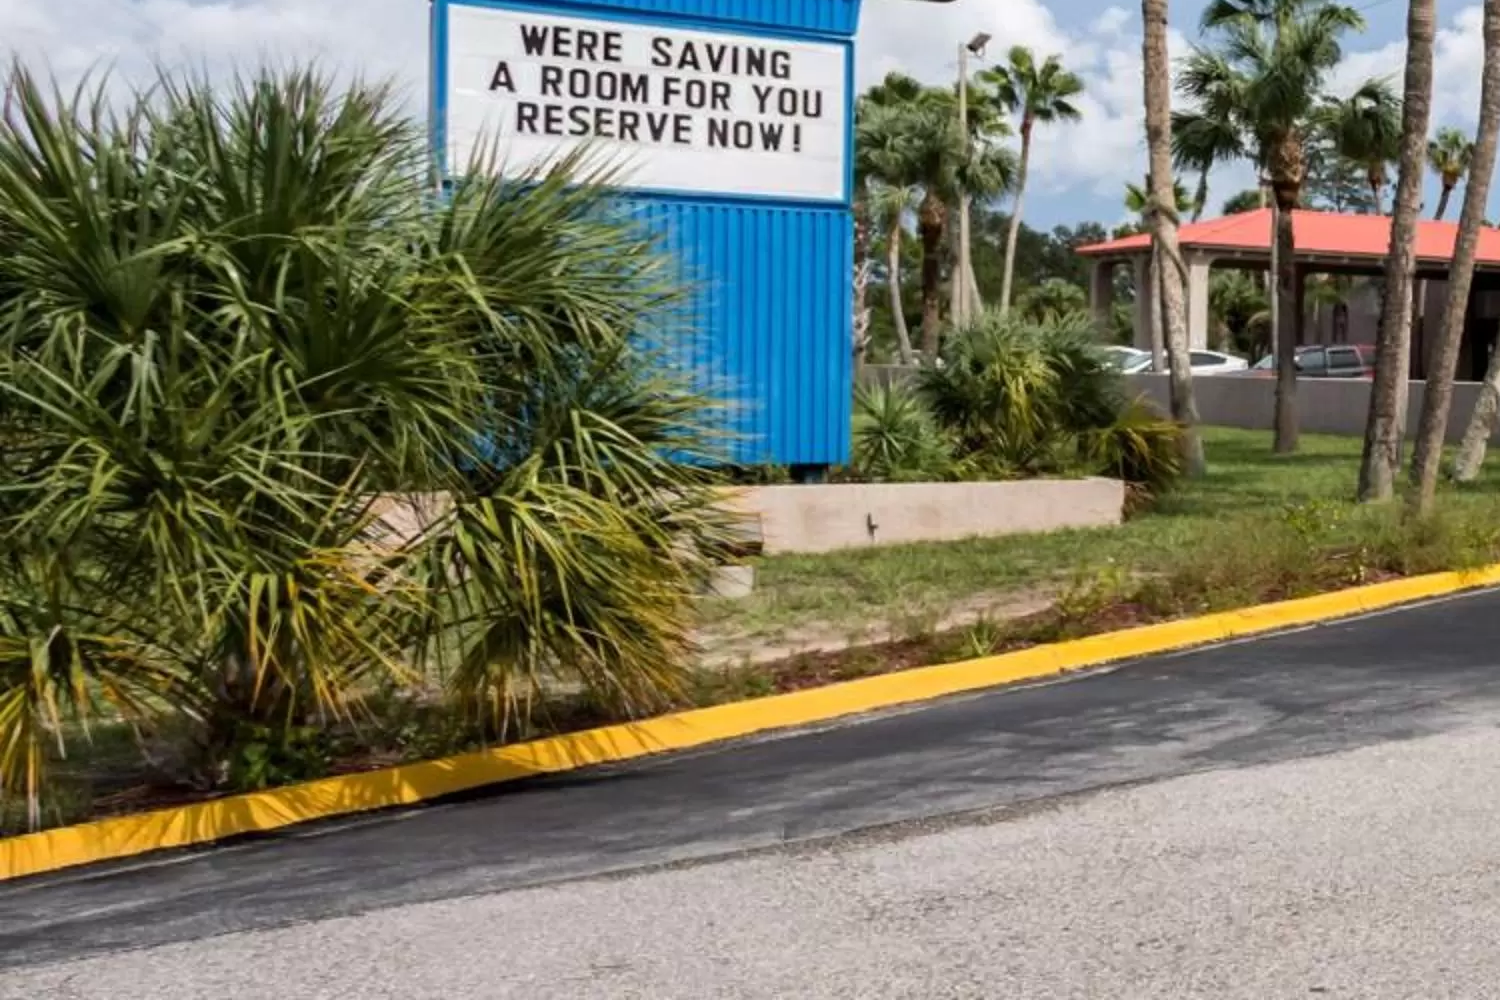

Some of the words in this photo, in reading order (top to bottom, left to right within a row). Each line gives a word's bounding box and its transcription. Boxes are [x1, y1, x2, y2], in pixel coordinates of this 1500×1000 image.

[520, 23, 623, 62] WERE
[651, 37, 792, 79] SAVING
[488, 61, 516, 93] A
[541, 65, 649, 105] ROOM
[662, 77, 731, 111] FOR
[752, 85, 823, 119] YOU
[516, 101, 692, 145] RESERVE
[707, 117, 802, 152] NOW!
